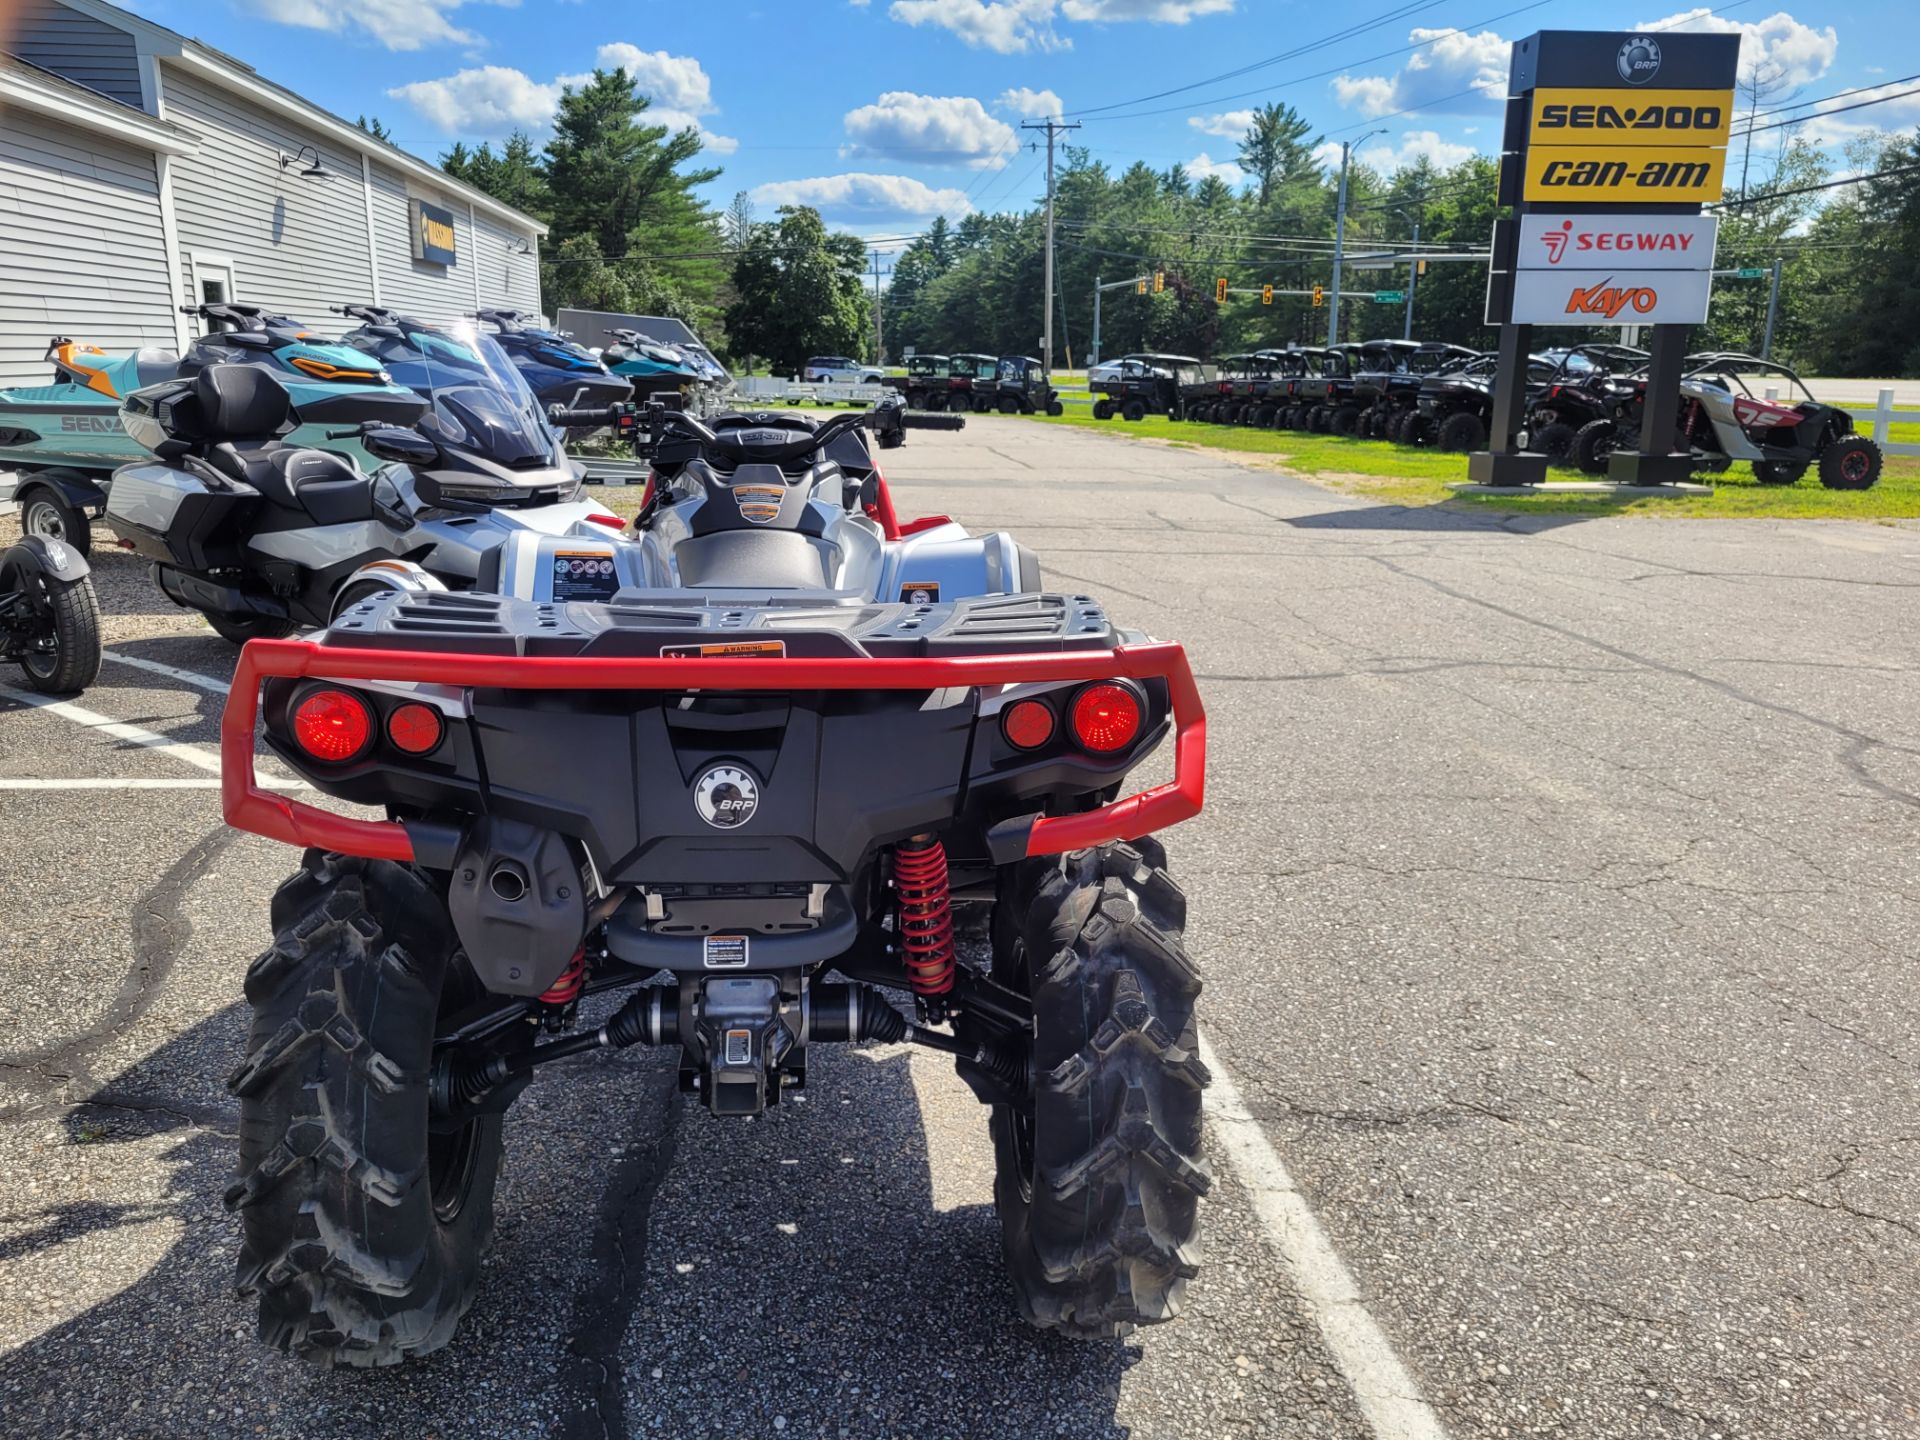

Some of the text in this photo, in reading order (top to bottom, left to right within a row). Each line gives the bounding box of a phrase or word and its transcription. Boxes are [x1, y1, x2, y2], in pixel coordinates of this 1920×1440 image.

[1634, 61, 1657, 70] BRP
[1540, 161, 1711, 187] can-am
[1576, 233, 1694, 251] SEGWAY
[1565, 277, 1657, 318] KAYO
[720, 800, 754, 810] BRP
